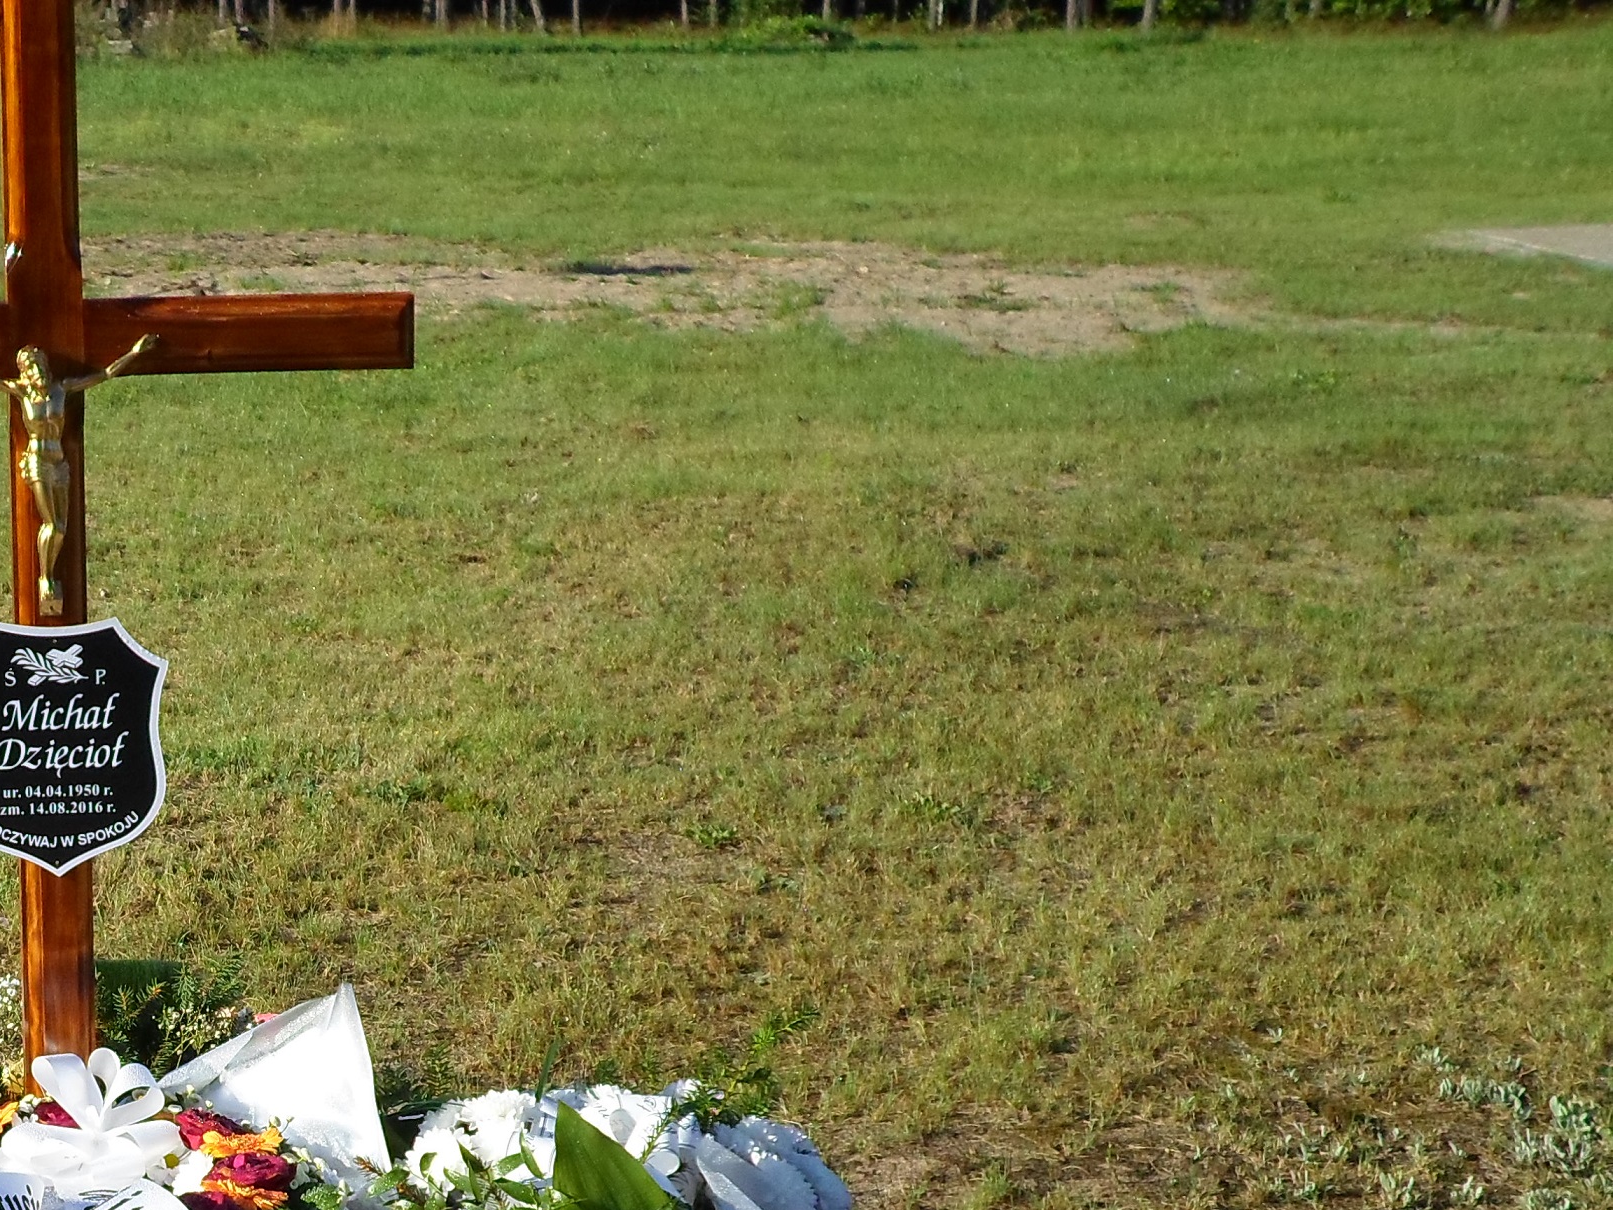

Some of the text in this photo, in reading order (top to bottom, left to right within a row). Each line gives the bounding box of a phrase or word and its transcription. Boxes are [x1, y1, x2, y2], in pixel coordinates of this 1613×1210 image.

[95, 669, 107, 685] P.
[1, 693, 120, 731] Michał
[2, 784, 114, 798] ur. 04.04.1950 r.
[0, 801, 117, 816] zm. 14.08.2016 r.
[61, 834, 75, 847] W
[77, 811, 140, 846] SPOKOJU
